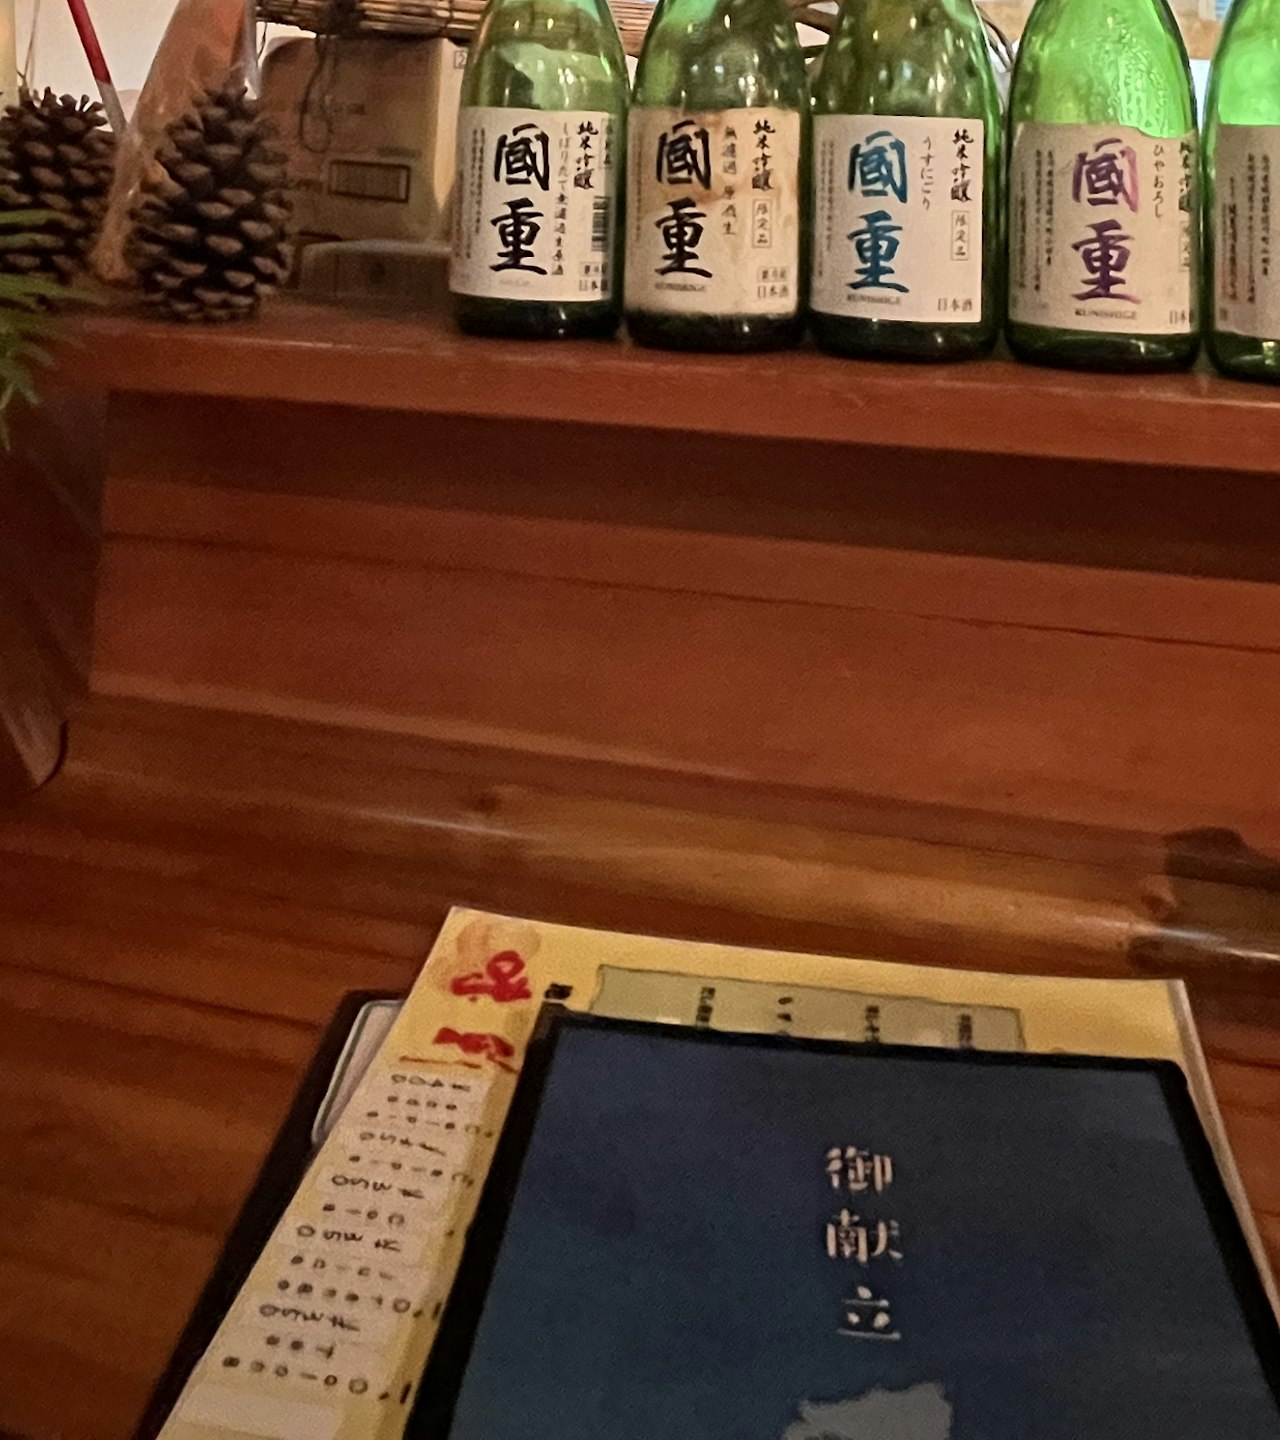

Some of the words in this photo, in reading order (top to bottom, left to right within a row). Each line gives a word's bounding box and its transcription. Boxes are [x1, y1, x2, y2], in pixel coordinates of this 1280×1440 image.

[489, 122, 551, 276] 國重
[654, 119, 714, 279] 國重
[847, 130, 911, 293] 國重
[920, 136, 935, 210] うすにごり
[950, 128, 975, 203] 純米吟醸
[1071, 137, 1143, 305] 國重
[1153, 144, 1166, 219] ひやおろし
[937, 298, 974, 312] 日本酒
[825, 1144, 904, 1341] 御献立
